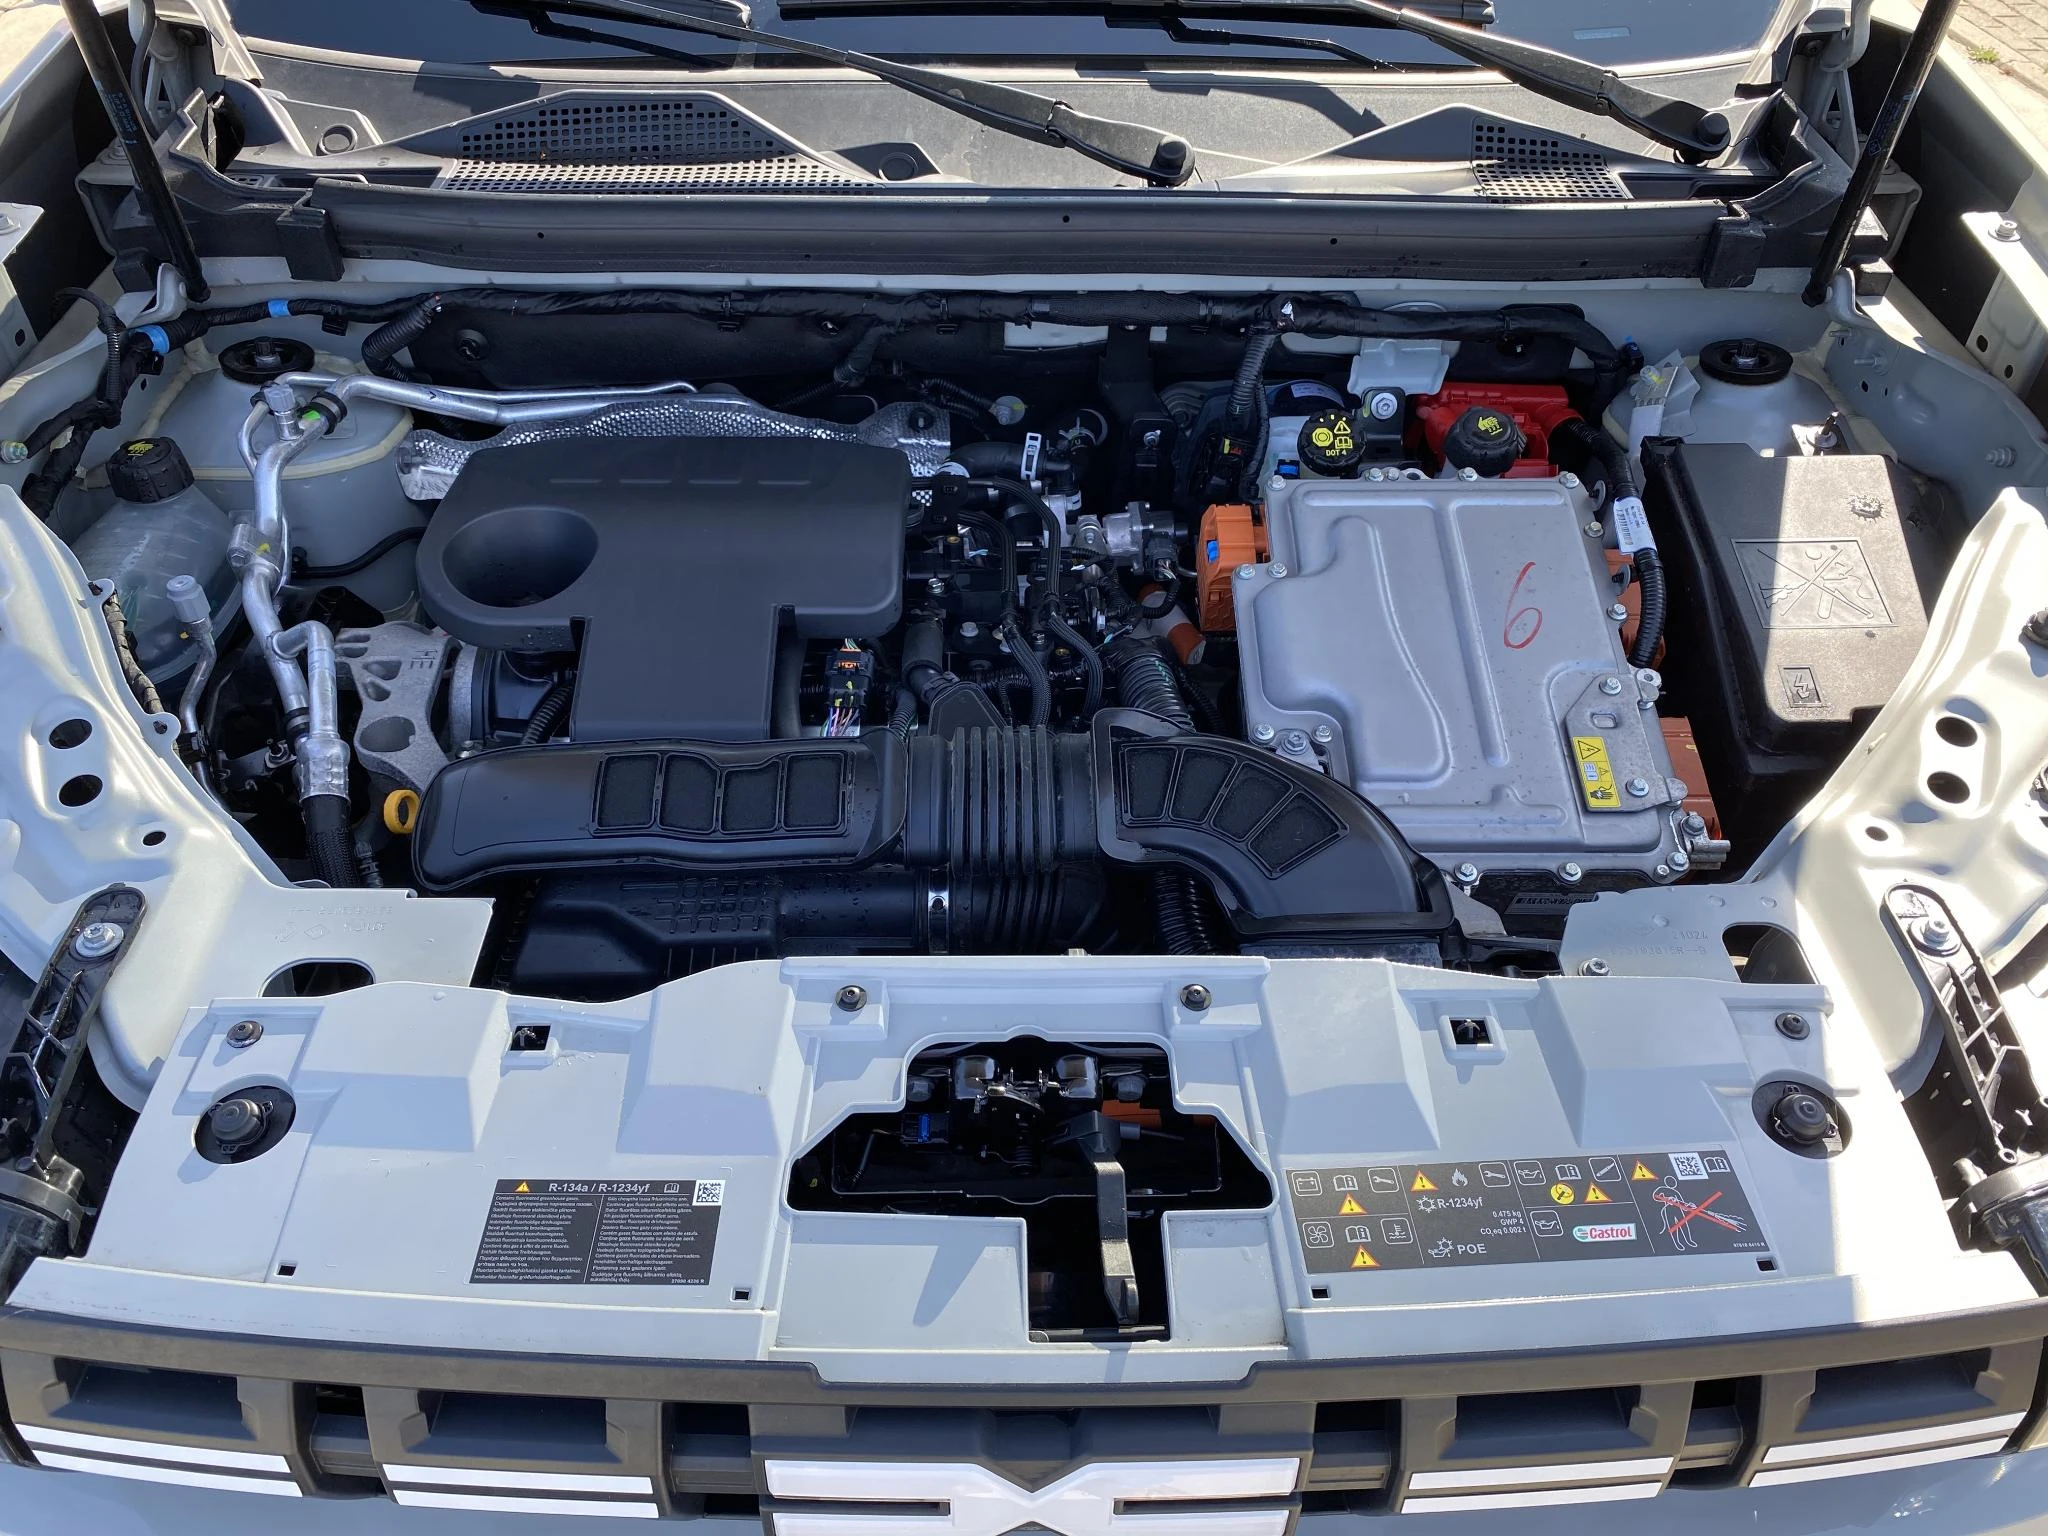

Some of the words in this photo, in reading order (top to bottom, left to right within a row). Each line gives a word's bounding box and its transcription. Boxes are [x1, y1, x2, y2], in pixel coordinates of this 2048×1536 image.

[1504, 561, 1542, 650] 6
[548, 1183, 589, 1192] R-134a
[590, 1183, 596, 1192] /
[598, 1184, 650, 1194] R-1234yf
[1437, 1196, 1483, 1209] R-1234yf
[1590, 1226, 1632, 1239] Castrol
[1457, 1243, 1487, 1254] POE
